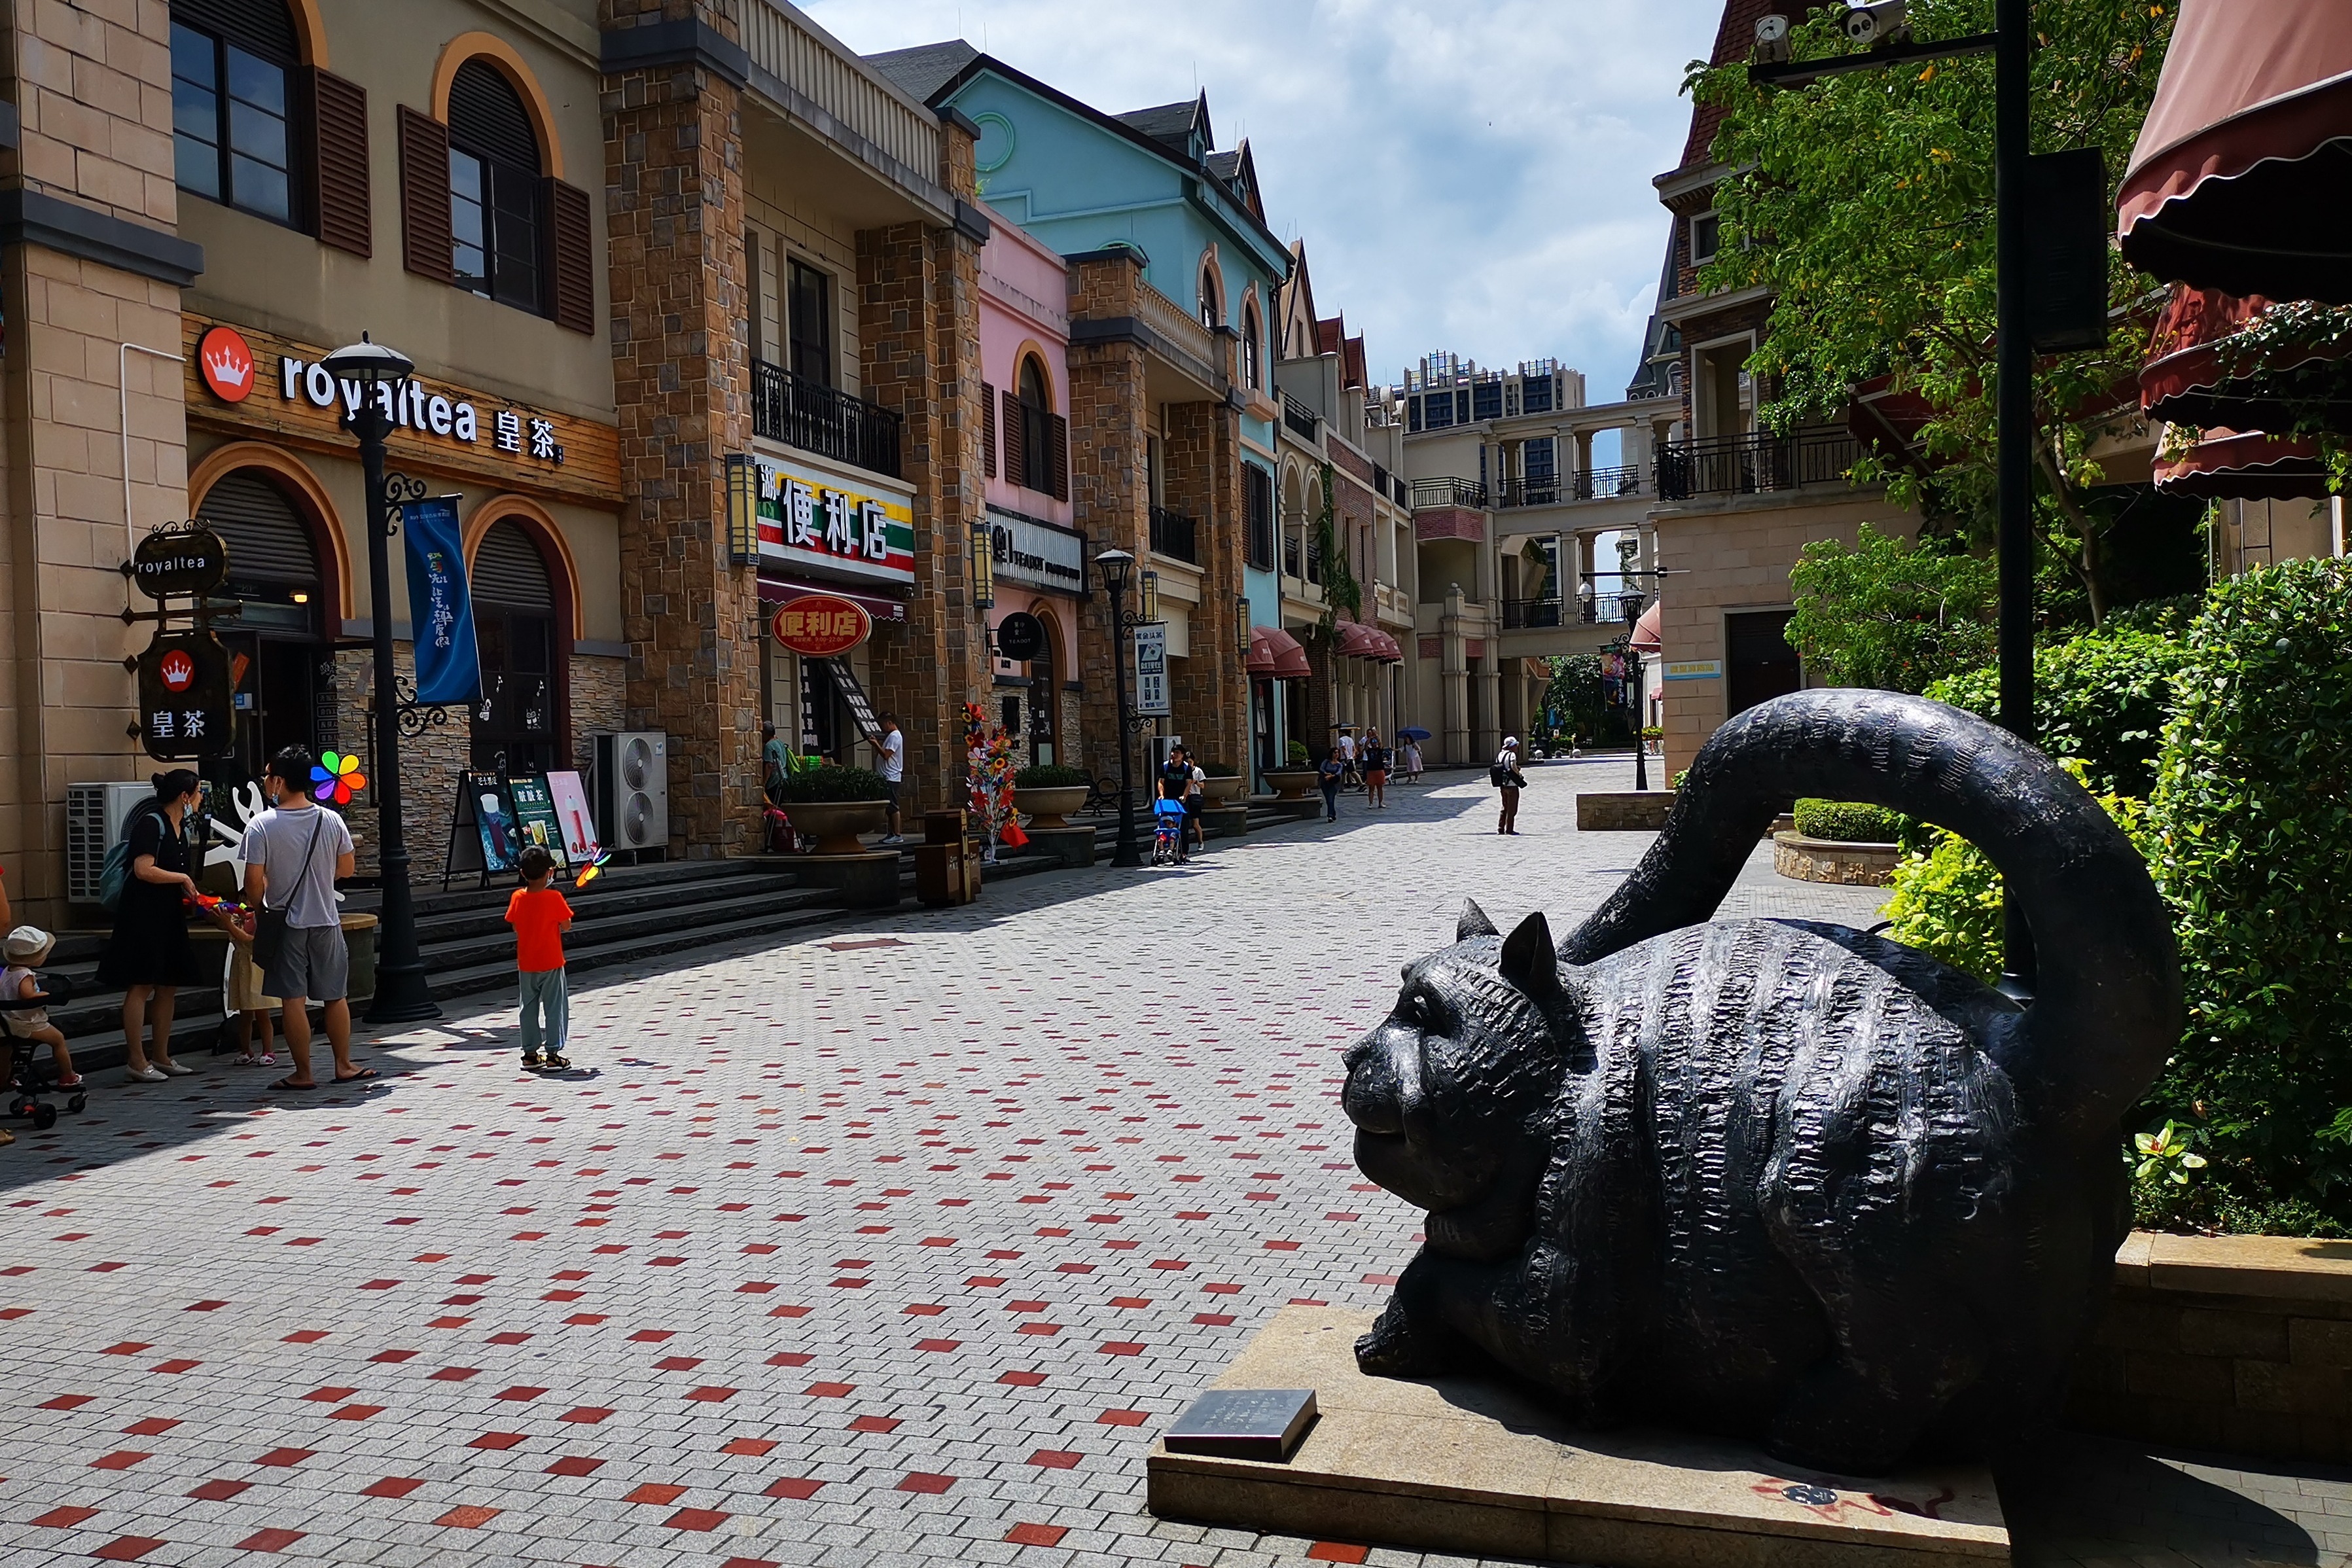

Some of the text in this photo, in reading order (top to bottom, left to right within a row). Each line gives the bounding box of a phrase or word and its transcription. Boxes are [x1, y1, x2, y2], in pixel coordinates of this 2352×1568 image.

[495, 410, 556, 459] 皇茶
[782, 478, 887, 561] 便利店
[137, 556, 205, 578] royaltea
[779, 610, 857, 637] 便利店
[151, 709, 205, 739] 皇茶
